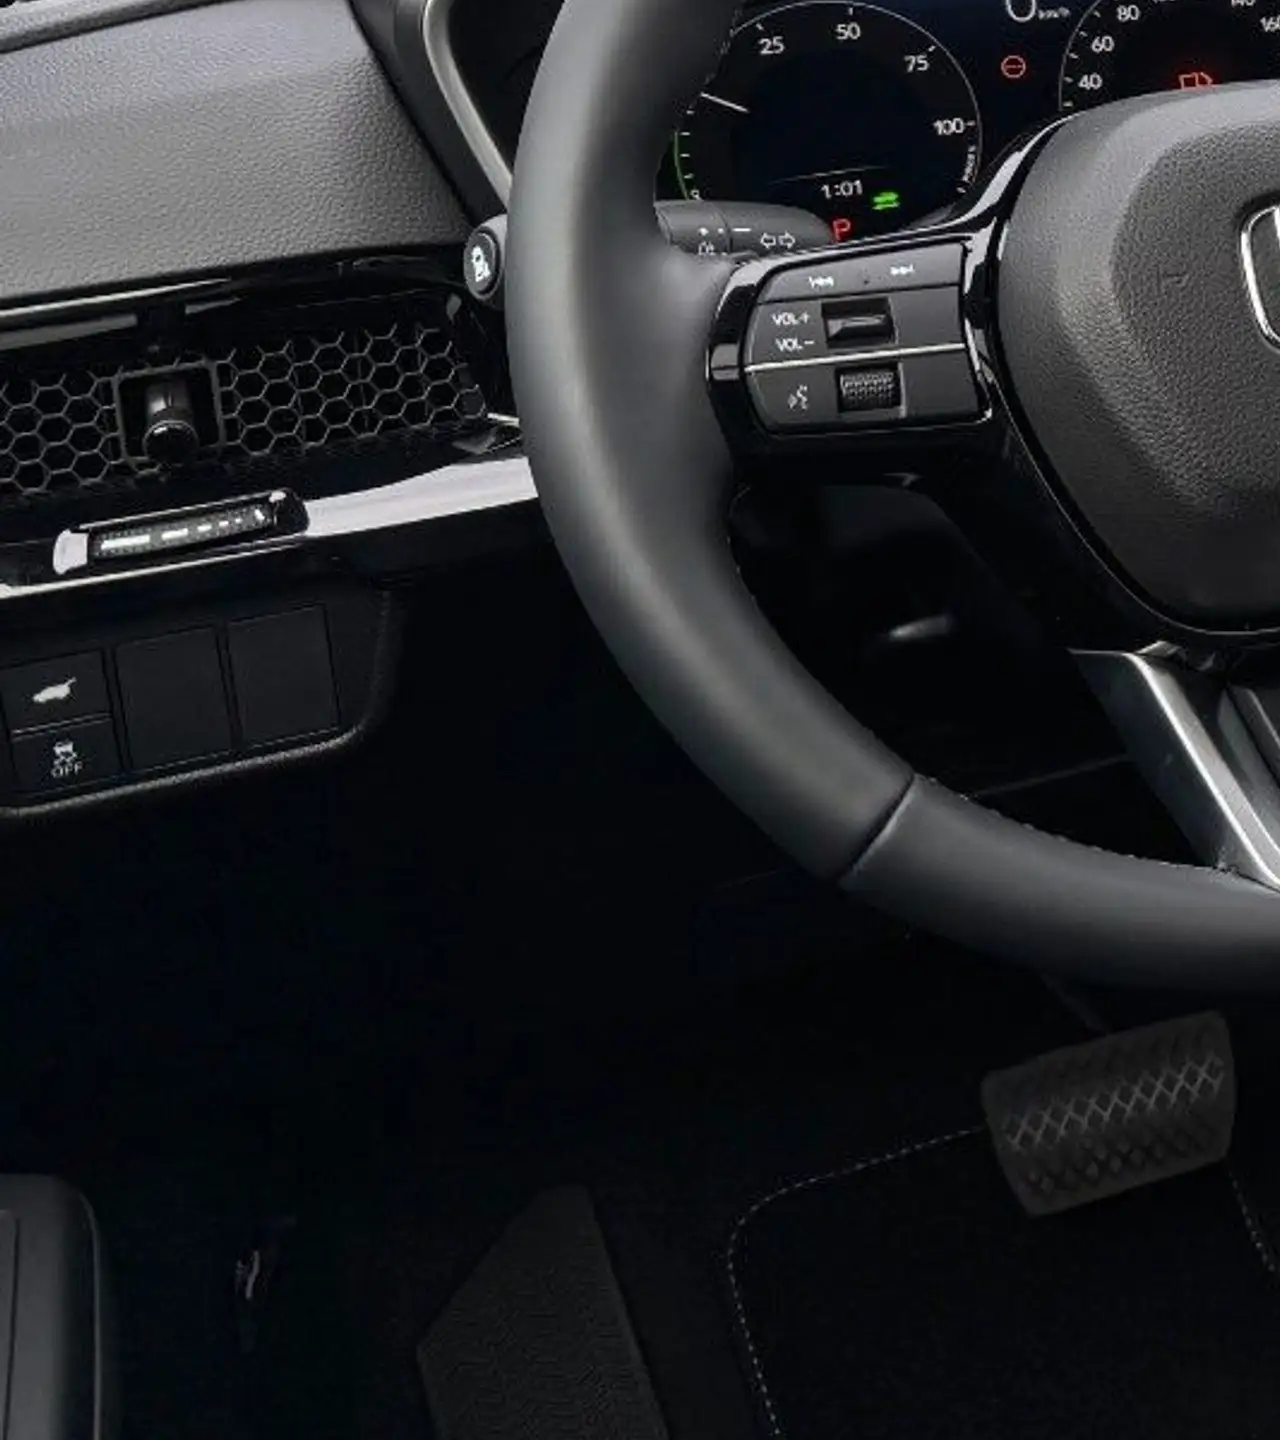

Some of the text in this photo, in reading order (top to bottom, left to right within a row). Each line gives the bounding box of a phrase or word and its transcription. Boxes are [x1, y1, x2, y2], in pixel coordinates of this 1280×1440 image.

[1116, 4, 1140, 22] 80
[835, 22, 861, 41] 50
[759, 35, 785, 56] 25
[1091, 35, 1115, 53] 60
[904, 55, 930, 73] 75
[1078, 73, 1103, 90] 40
[933, 117, 965, 137] 100
[820, 180, 863, 200] 1:01
[832, 217, 851, 243] P
[50, 761, 83, 779] OFF
